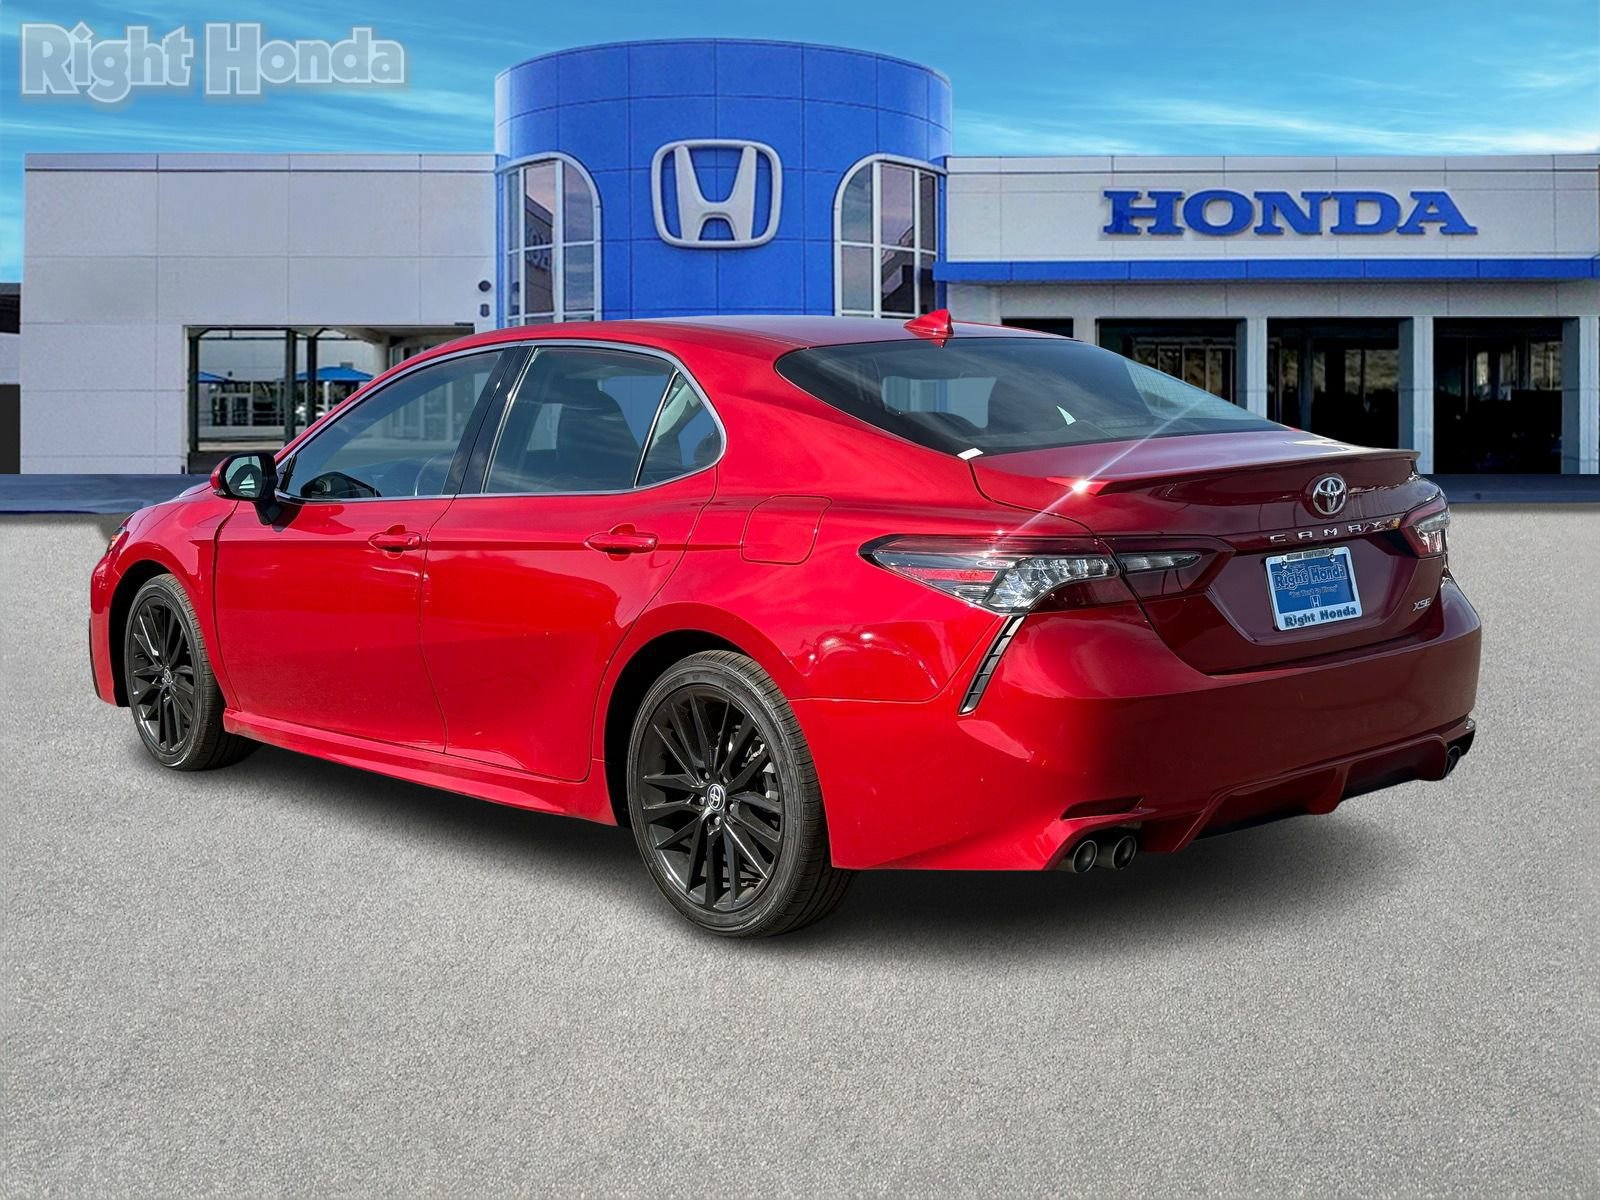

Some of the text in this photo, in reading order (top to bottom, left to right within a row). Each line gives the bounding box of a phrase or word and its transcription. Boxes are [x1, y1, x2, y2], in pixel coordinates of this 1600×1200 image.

[1104, 190, 1478, 235] HONDA
[1270, 521, 1383, 543] CAMRY
[1273, 562, 1347, 590] Right Honda
[1412, 598, 1431, 612] XSE
[1284, 606, 1357, 627] Right Honda
